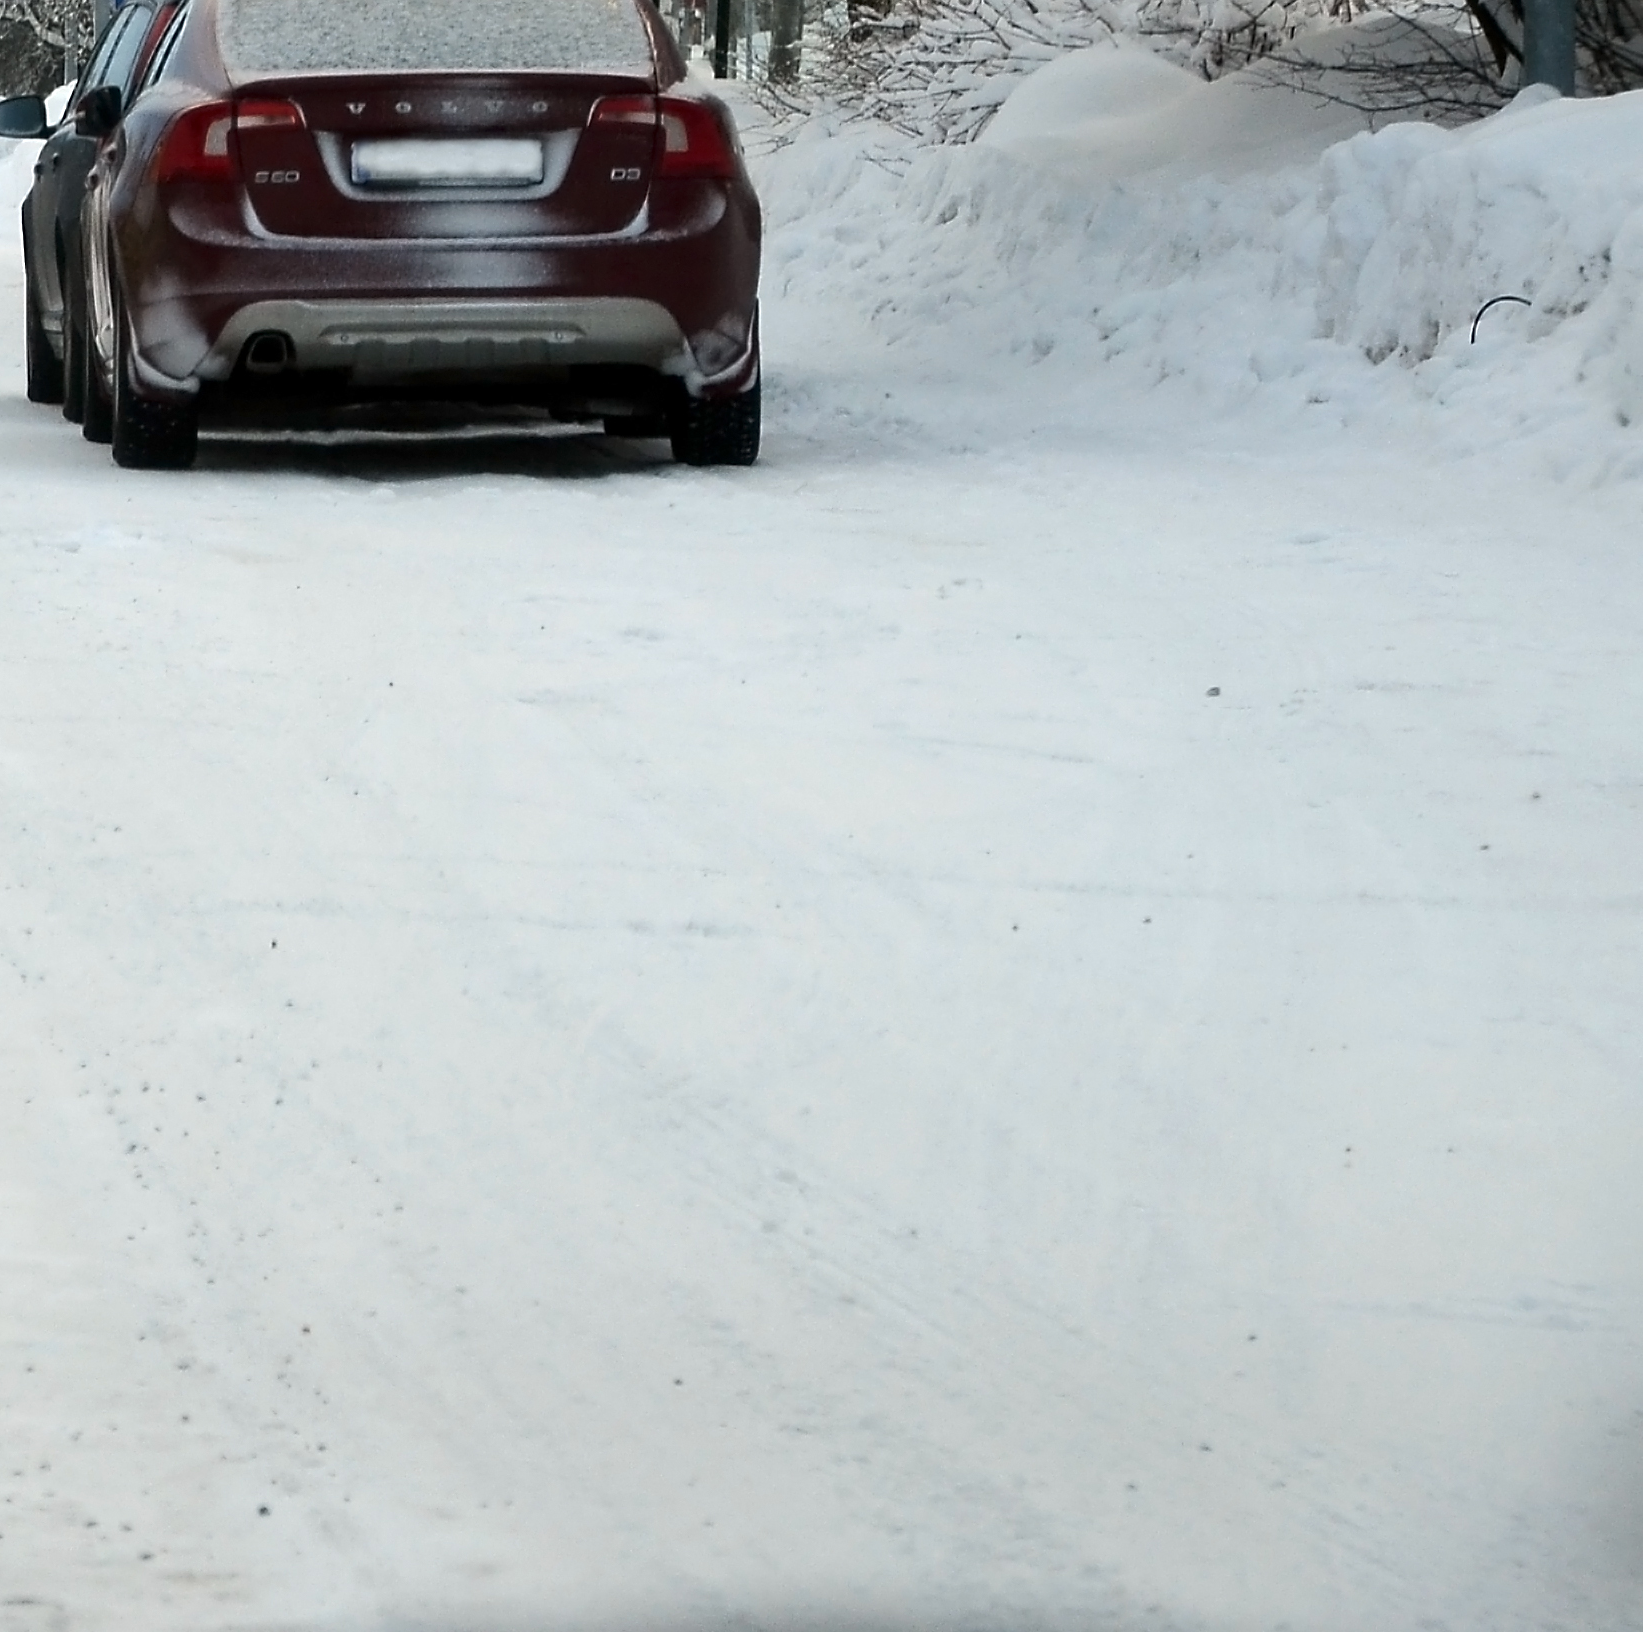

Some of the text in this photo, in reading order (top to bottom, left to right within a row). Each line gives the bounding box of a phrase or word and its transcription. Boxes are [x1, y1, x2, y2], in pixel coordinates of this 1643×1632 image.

[347, 102, 549, 114] VOLVO
[254, 171, 300, 184] S60
[610, 169, 642, 181] D3
